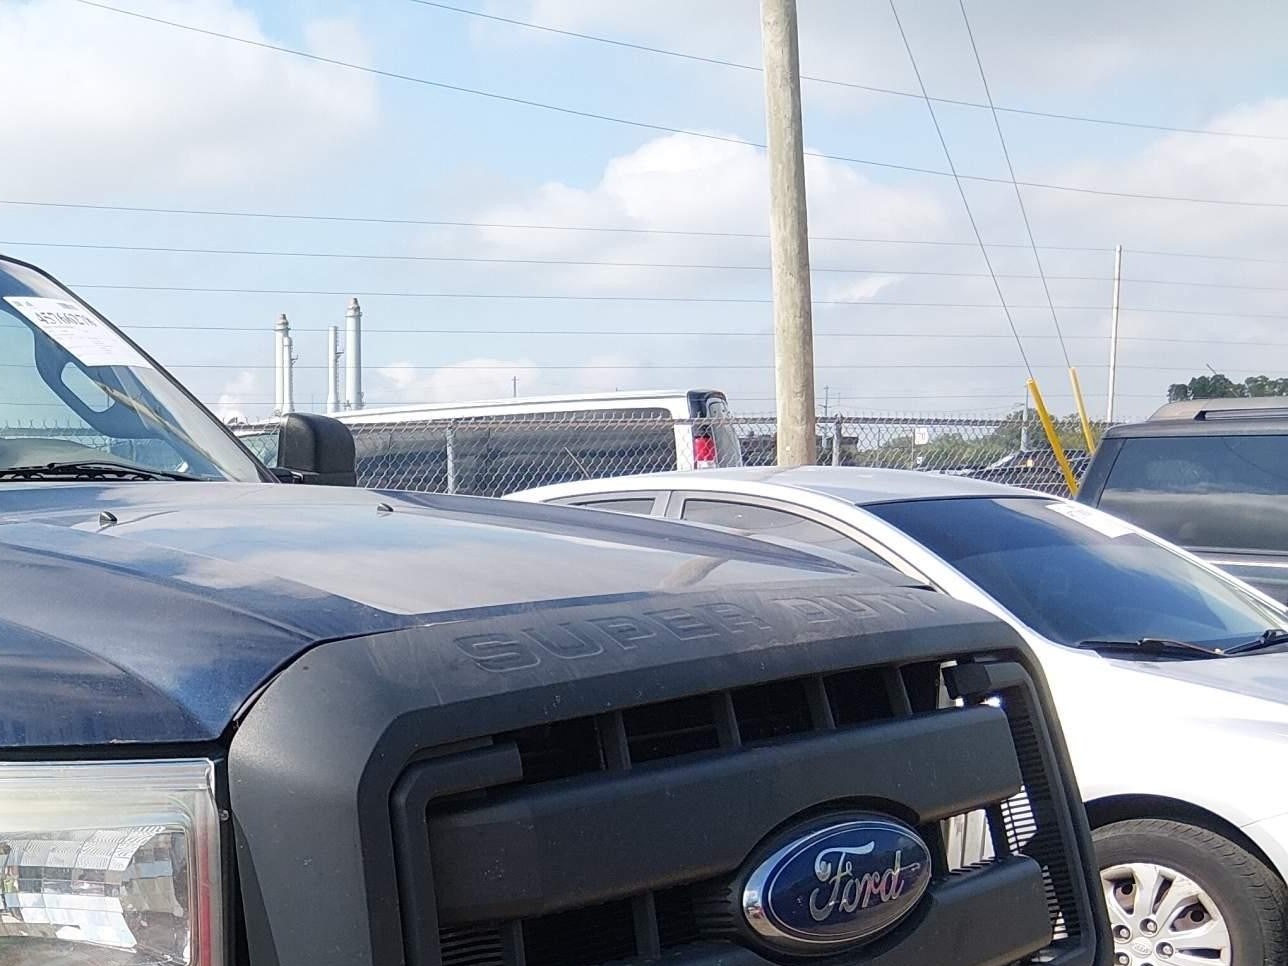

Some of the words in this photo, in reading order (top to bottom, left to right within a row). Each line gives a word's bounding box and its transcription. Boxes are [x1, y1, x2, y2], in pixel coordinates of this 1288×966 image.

[453, 601, 773, 674] SUPER
[769, 593, 939, 625] DUTY
[809, 840, 921, 922] Ford
